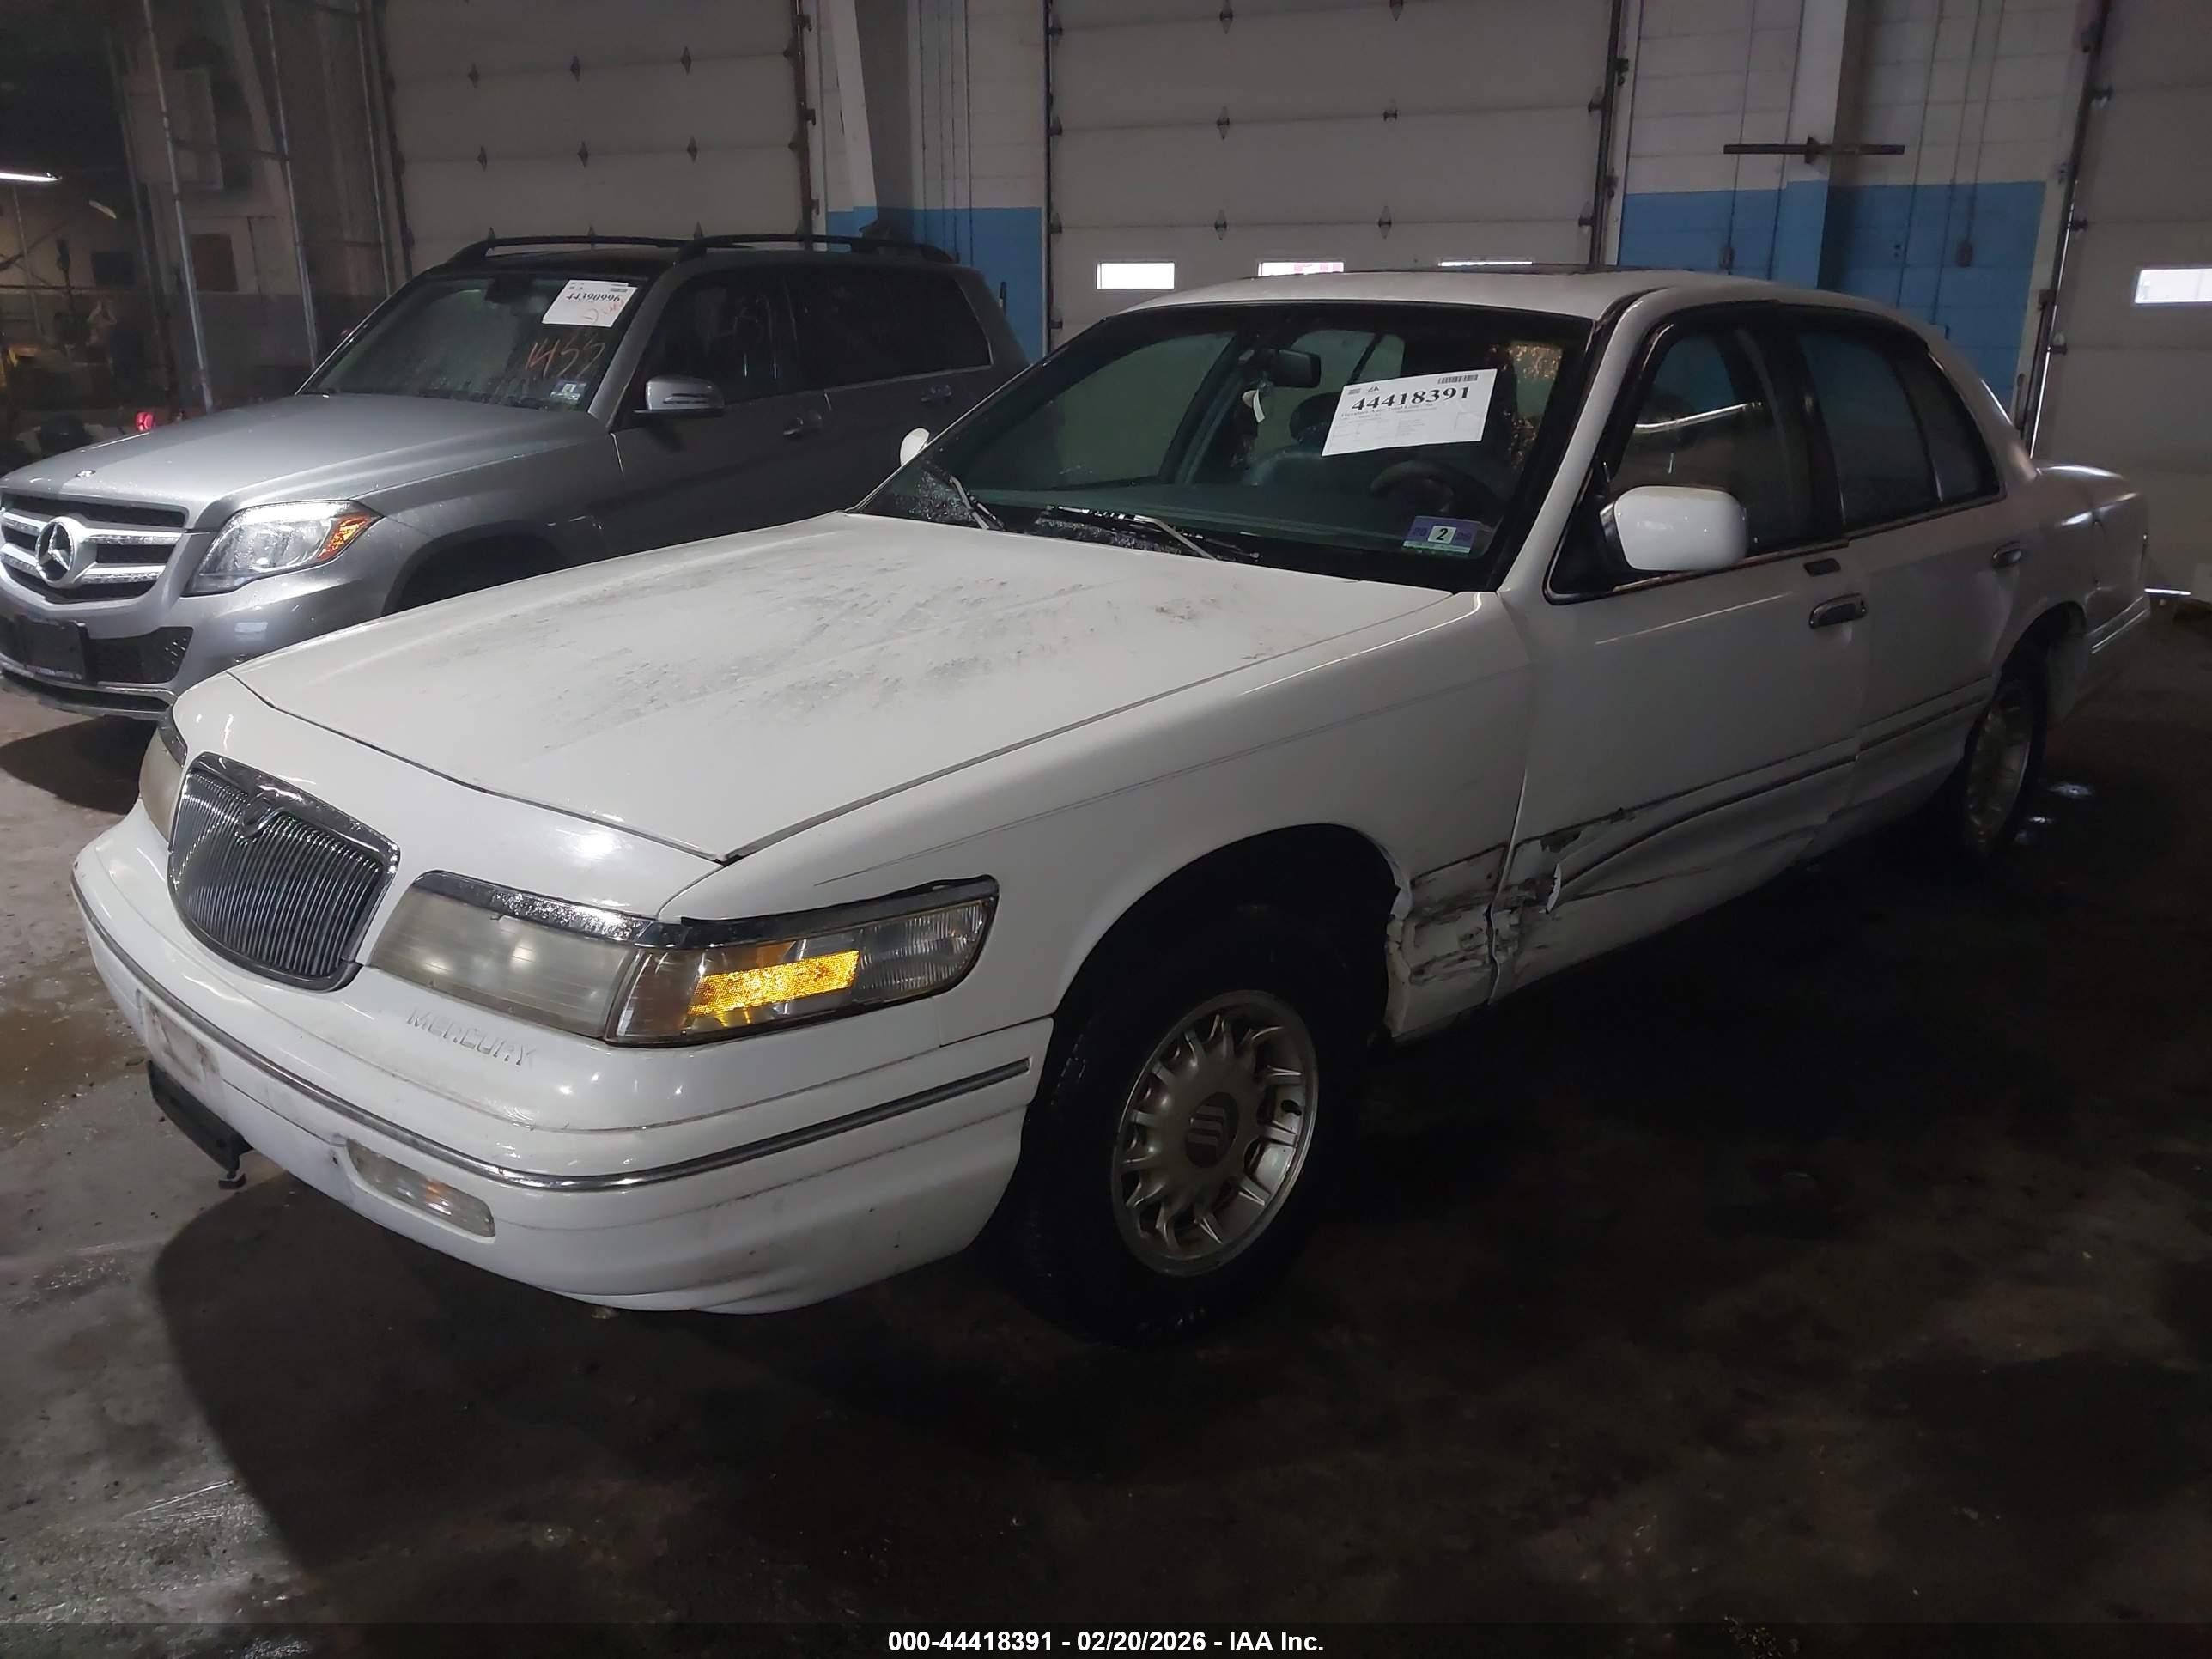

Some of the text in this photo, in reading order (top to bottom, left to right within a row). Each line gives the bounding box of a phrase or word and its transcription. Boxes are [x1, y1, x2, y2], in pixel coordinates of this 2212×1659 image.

[566, 292, 620, 302] 44390996
[1351, 386, 1470, 411] 44418391
[1435, 527, 1449, 541] 2
[407, 1009, 537, 1066] MERCURY
